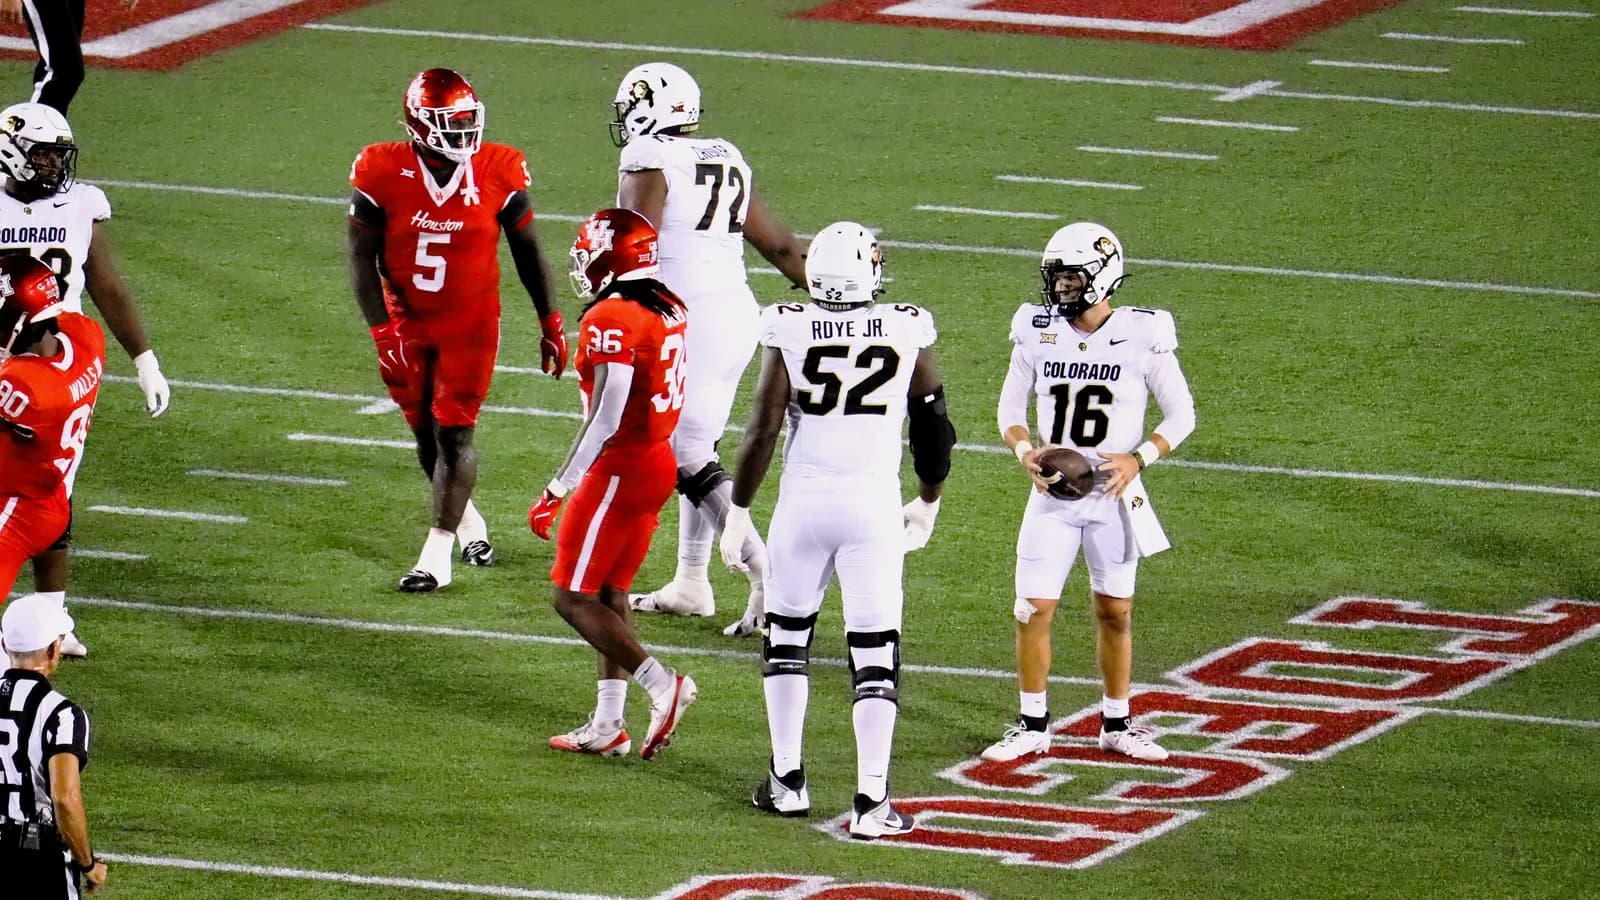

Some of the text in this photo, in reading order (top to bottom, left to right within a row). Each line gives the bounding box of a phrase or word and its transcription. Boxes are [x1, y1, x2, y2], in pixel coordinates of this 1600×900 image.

[695, 163, 745, 233] 72
[410, 210, 464, 232] Houston
[0, 227, 66, 243] OLORADO
[412, 232, 451, 292] 5
[826, 290, 842, 301] 52
[587, 324, 623, 354] 36
[812, 318, 888, 340] ROYE JR.
[797, 345, 900, 416] 52
[1044, 361, 1121, 382] COLORADO
[1050, 383, 1113, 448] 16
